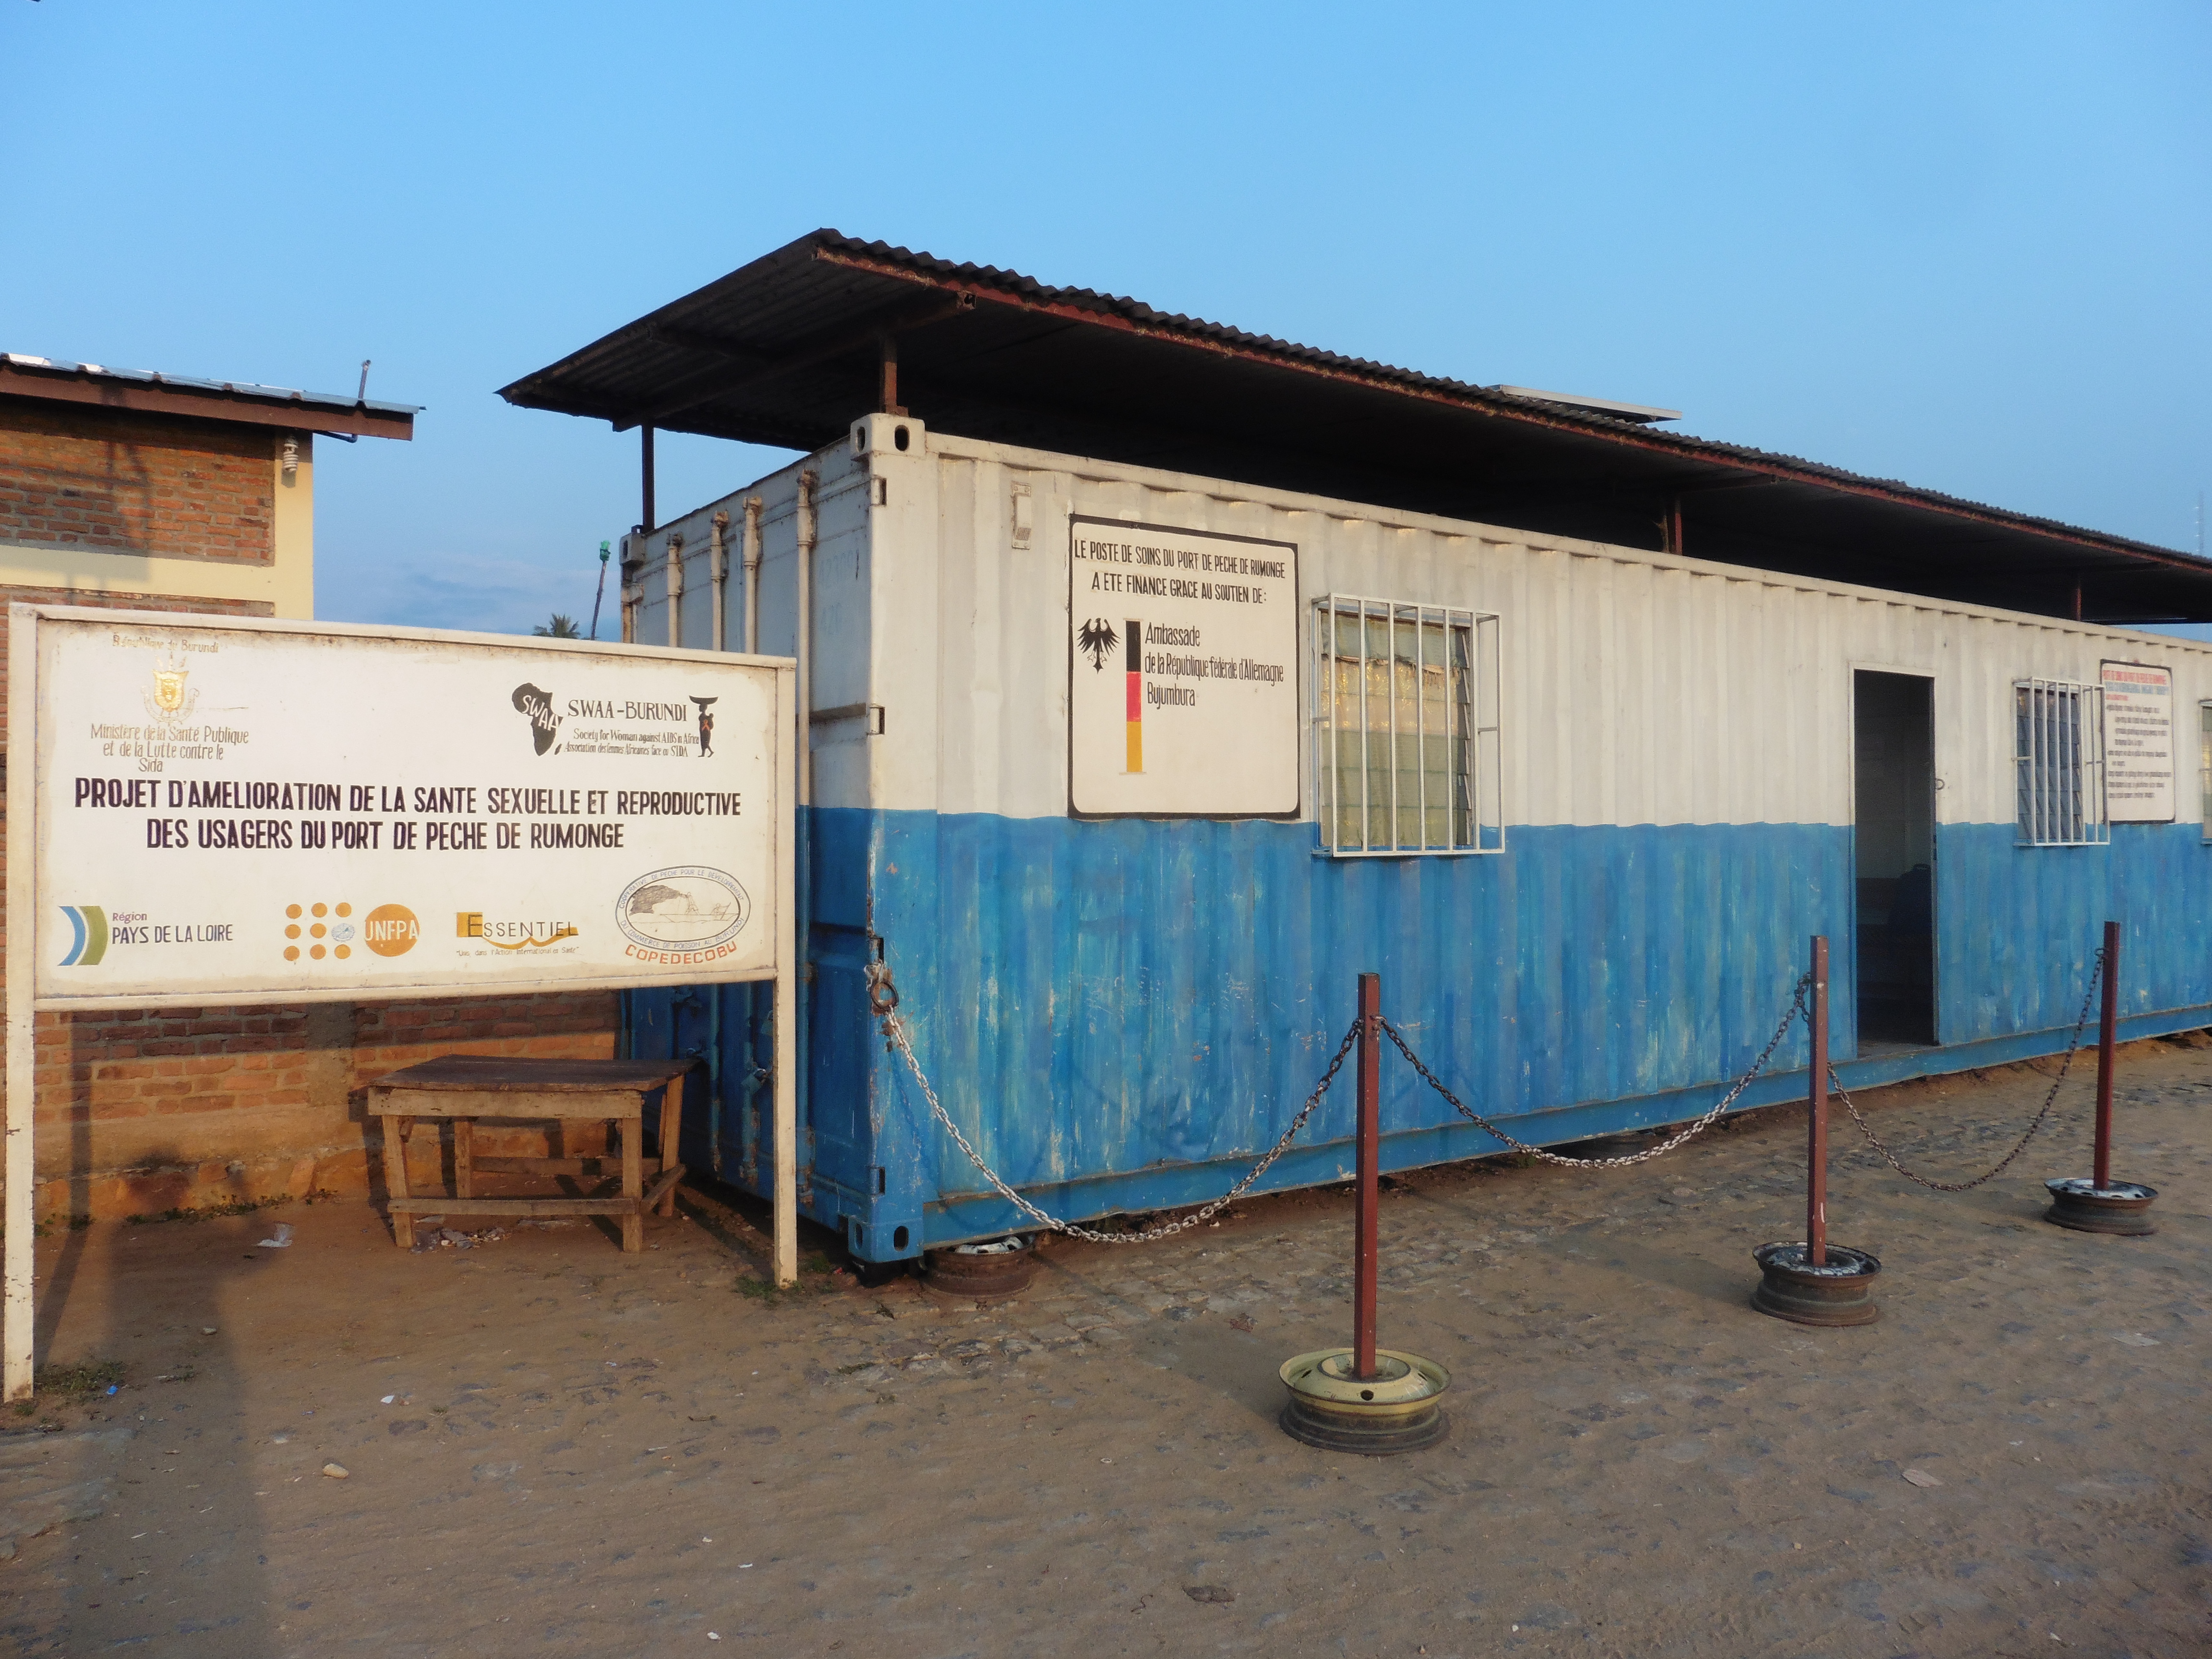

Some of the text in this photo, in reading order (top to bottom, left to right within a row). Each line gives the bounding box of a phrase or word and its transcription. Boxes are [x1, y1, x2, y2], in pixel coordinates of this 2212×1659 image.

[1075, 539, 1285, 578] LE POSTE DE SOINS DU PORT DE PECHE DE RUMONGE
[1092, 572, 1266, 604] A ETE FINANCE GRACE AU SOUTIEN DE:
[181, 639, 218, 652] Burundi
[1145, 622, 1200, 647] Ambassade
[1145, 652, 1283, 686] de la République fédérale d'Allemagne
[1148, 682, 1195, 709] Bujumbura
[522, 695, 560, 731] SWAA
[91, 723, 249, 745] Ministère de la Santé Publique
[574, 728, 598, 742] Society
[600, 729, 609, 740] for
[610, 729, 637, 741] Woman
[639, 732, 661, 744] against
[661, 732, 677, 743] AIDS
[103, 741, 224, 760] et de la Lutte contre le
[564, 741, 596, 753] Association
[671, 745, 688, 757] SIDA
[138, 757, 163, 772] Sida
[75, 777, 741, 816] PROJET D'AMELIORATION DE LA SANTE SEXUELLE ET REPRODUCTIVE
[147, 818, 624, 850] DES USAGERS DU PORT DE PECHE DE RUMONGE
[619, 878, 648, 909] COOPERATIVE
[113, 911, 147, 924] Région
[112, 924, 233, 944] PAYS DE LA LOIRE
[363, 920, 420, 942] UNFPA
[620, 920, 629, 929] DU
[627, 929, 660, 947] COMMERCE
[715, 918, 745, 942] BURUNDI
[625, 940, 737, 964] COPEDECOBU
